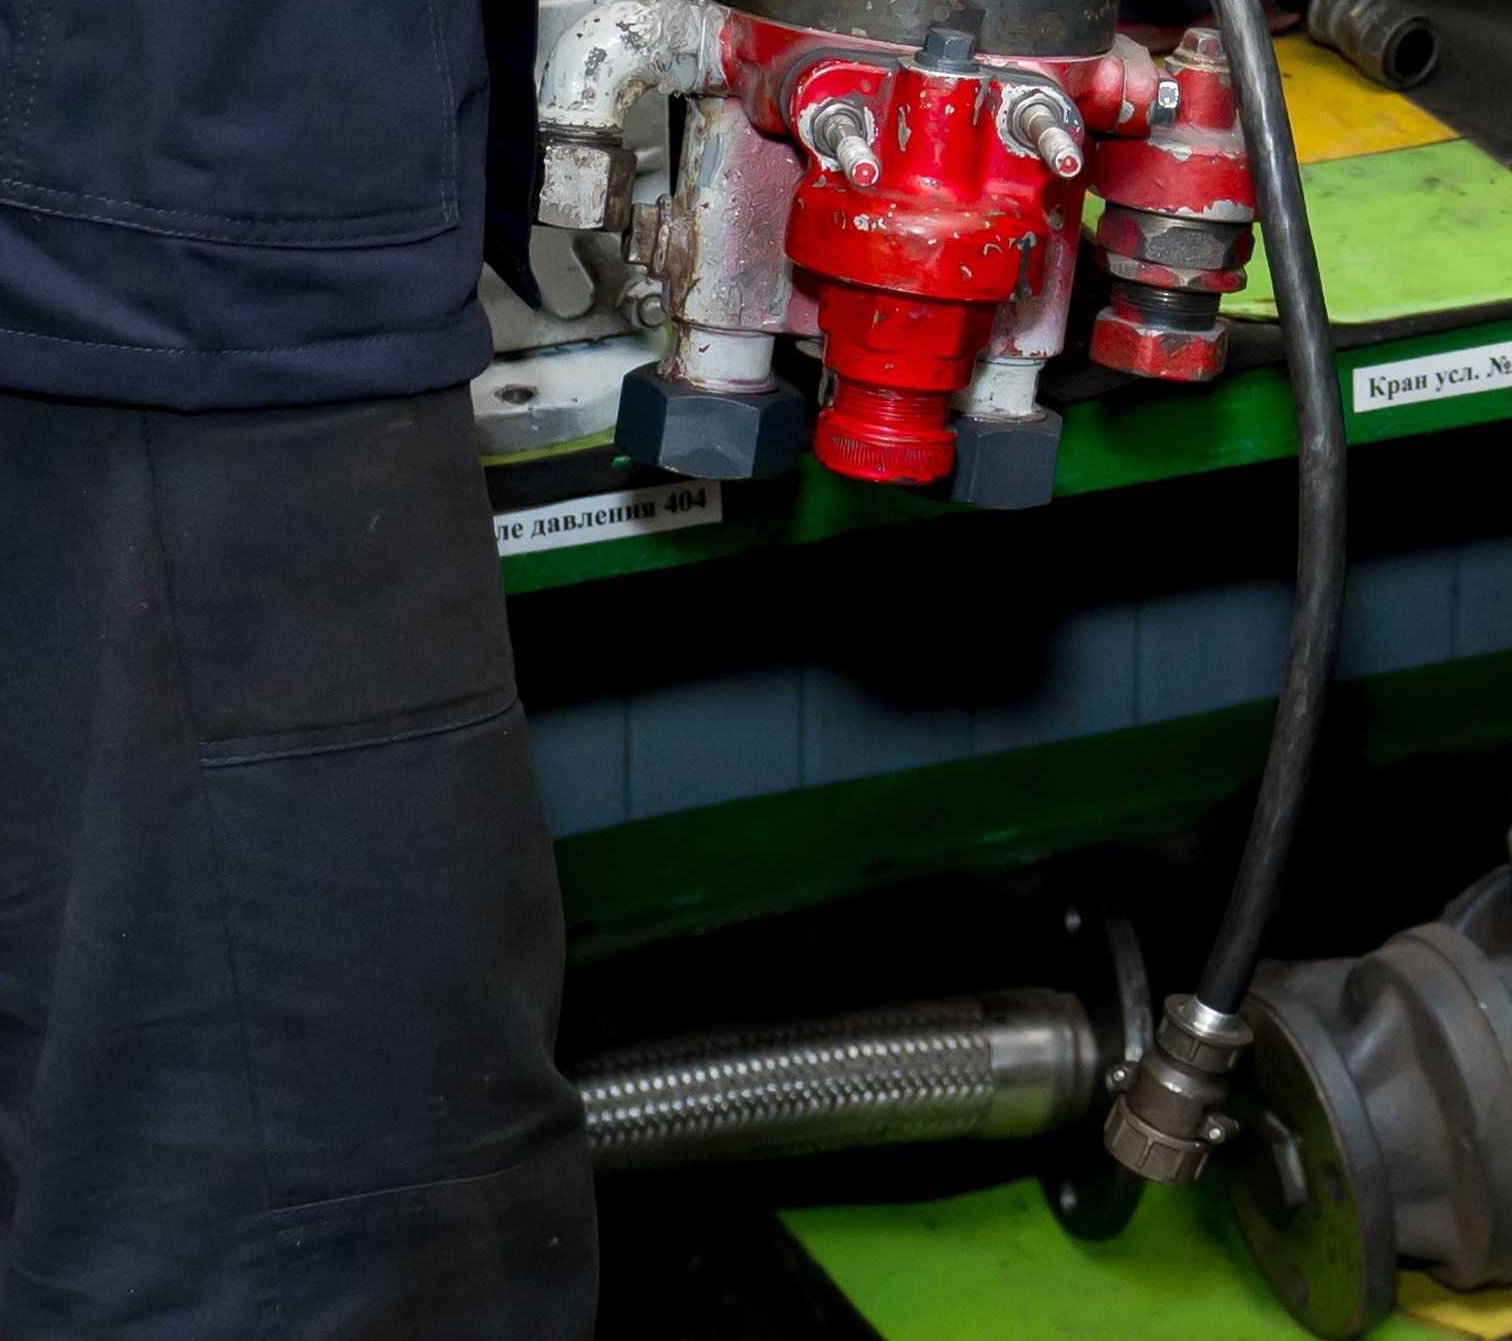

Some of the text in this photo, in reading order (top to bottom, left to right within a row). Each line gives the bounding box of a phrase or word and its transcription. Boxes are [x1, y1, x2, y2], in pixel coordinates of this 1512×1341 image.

[1368, 374, 1428, 402] Кран
[1435, 364, 1480, 392] усл.
[530, 499, 656, 538] давления
[664, 487, 708, 514] 404
